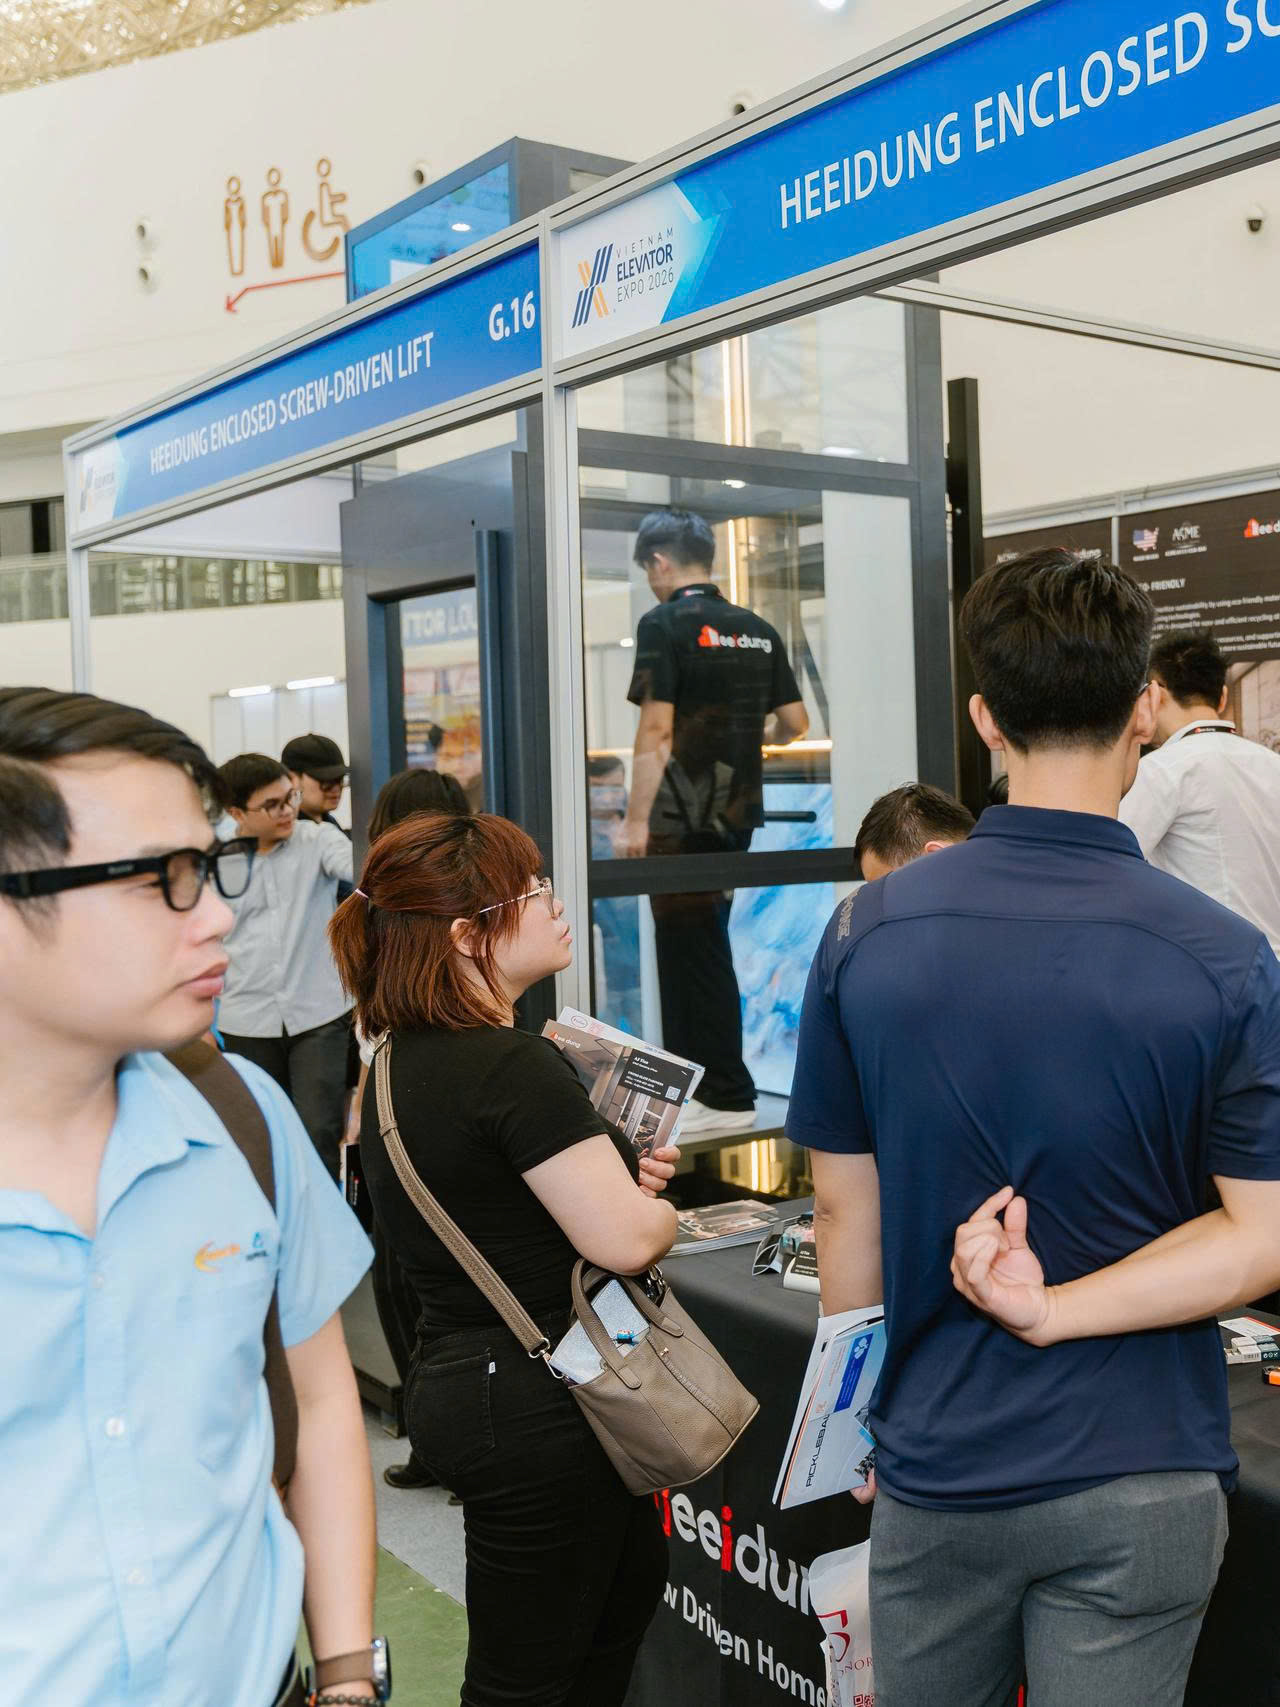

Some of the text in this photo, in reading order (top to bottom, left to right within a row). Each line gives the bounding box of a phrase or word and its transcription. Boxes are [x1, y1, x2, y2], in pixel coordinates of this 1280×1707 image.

[780, 112, 961, 229] HEEIDUNG
[975, 12, 1208, 154] ENCLOSED
[616, 227, 673, 258] VIETNAM
[617, 243, 673, 282] ELEVATOR
[617, 267, 674, 302] EXPO 2026
[489, 291, 535, 341] G.16
[150, 332, 434, 475] HEEIDUNG ENCLOSED SCREW-DRIVEN LIFT
[683, 1585, 750, 1665] Driven
